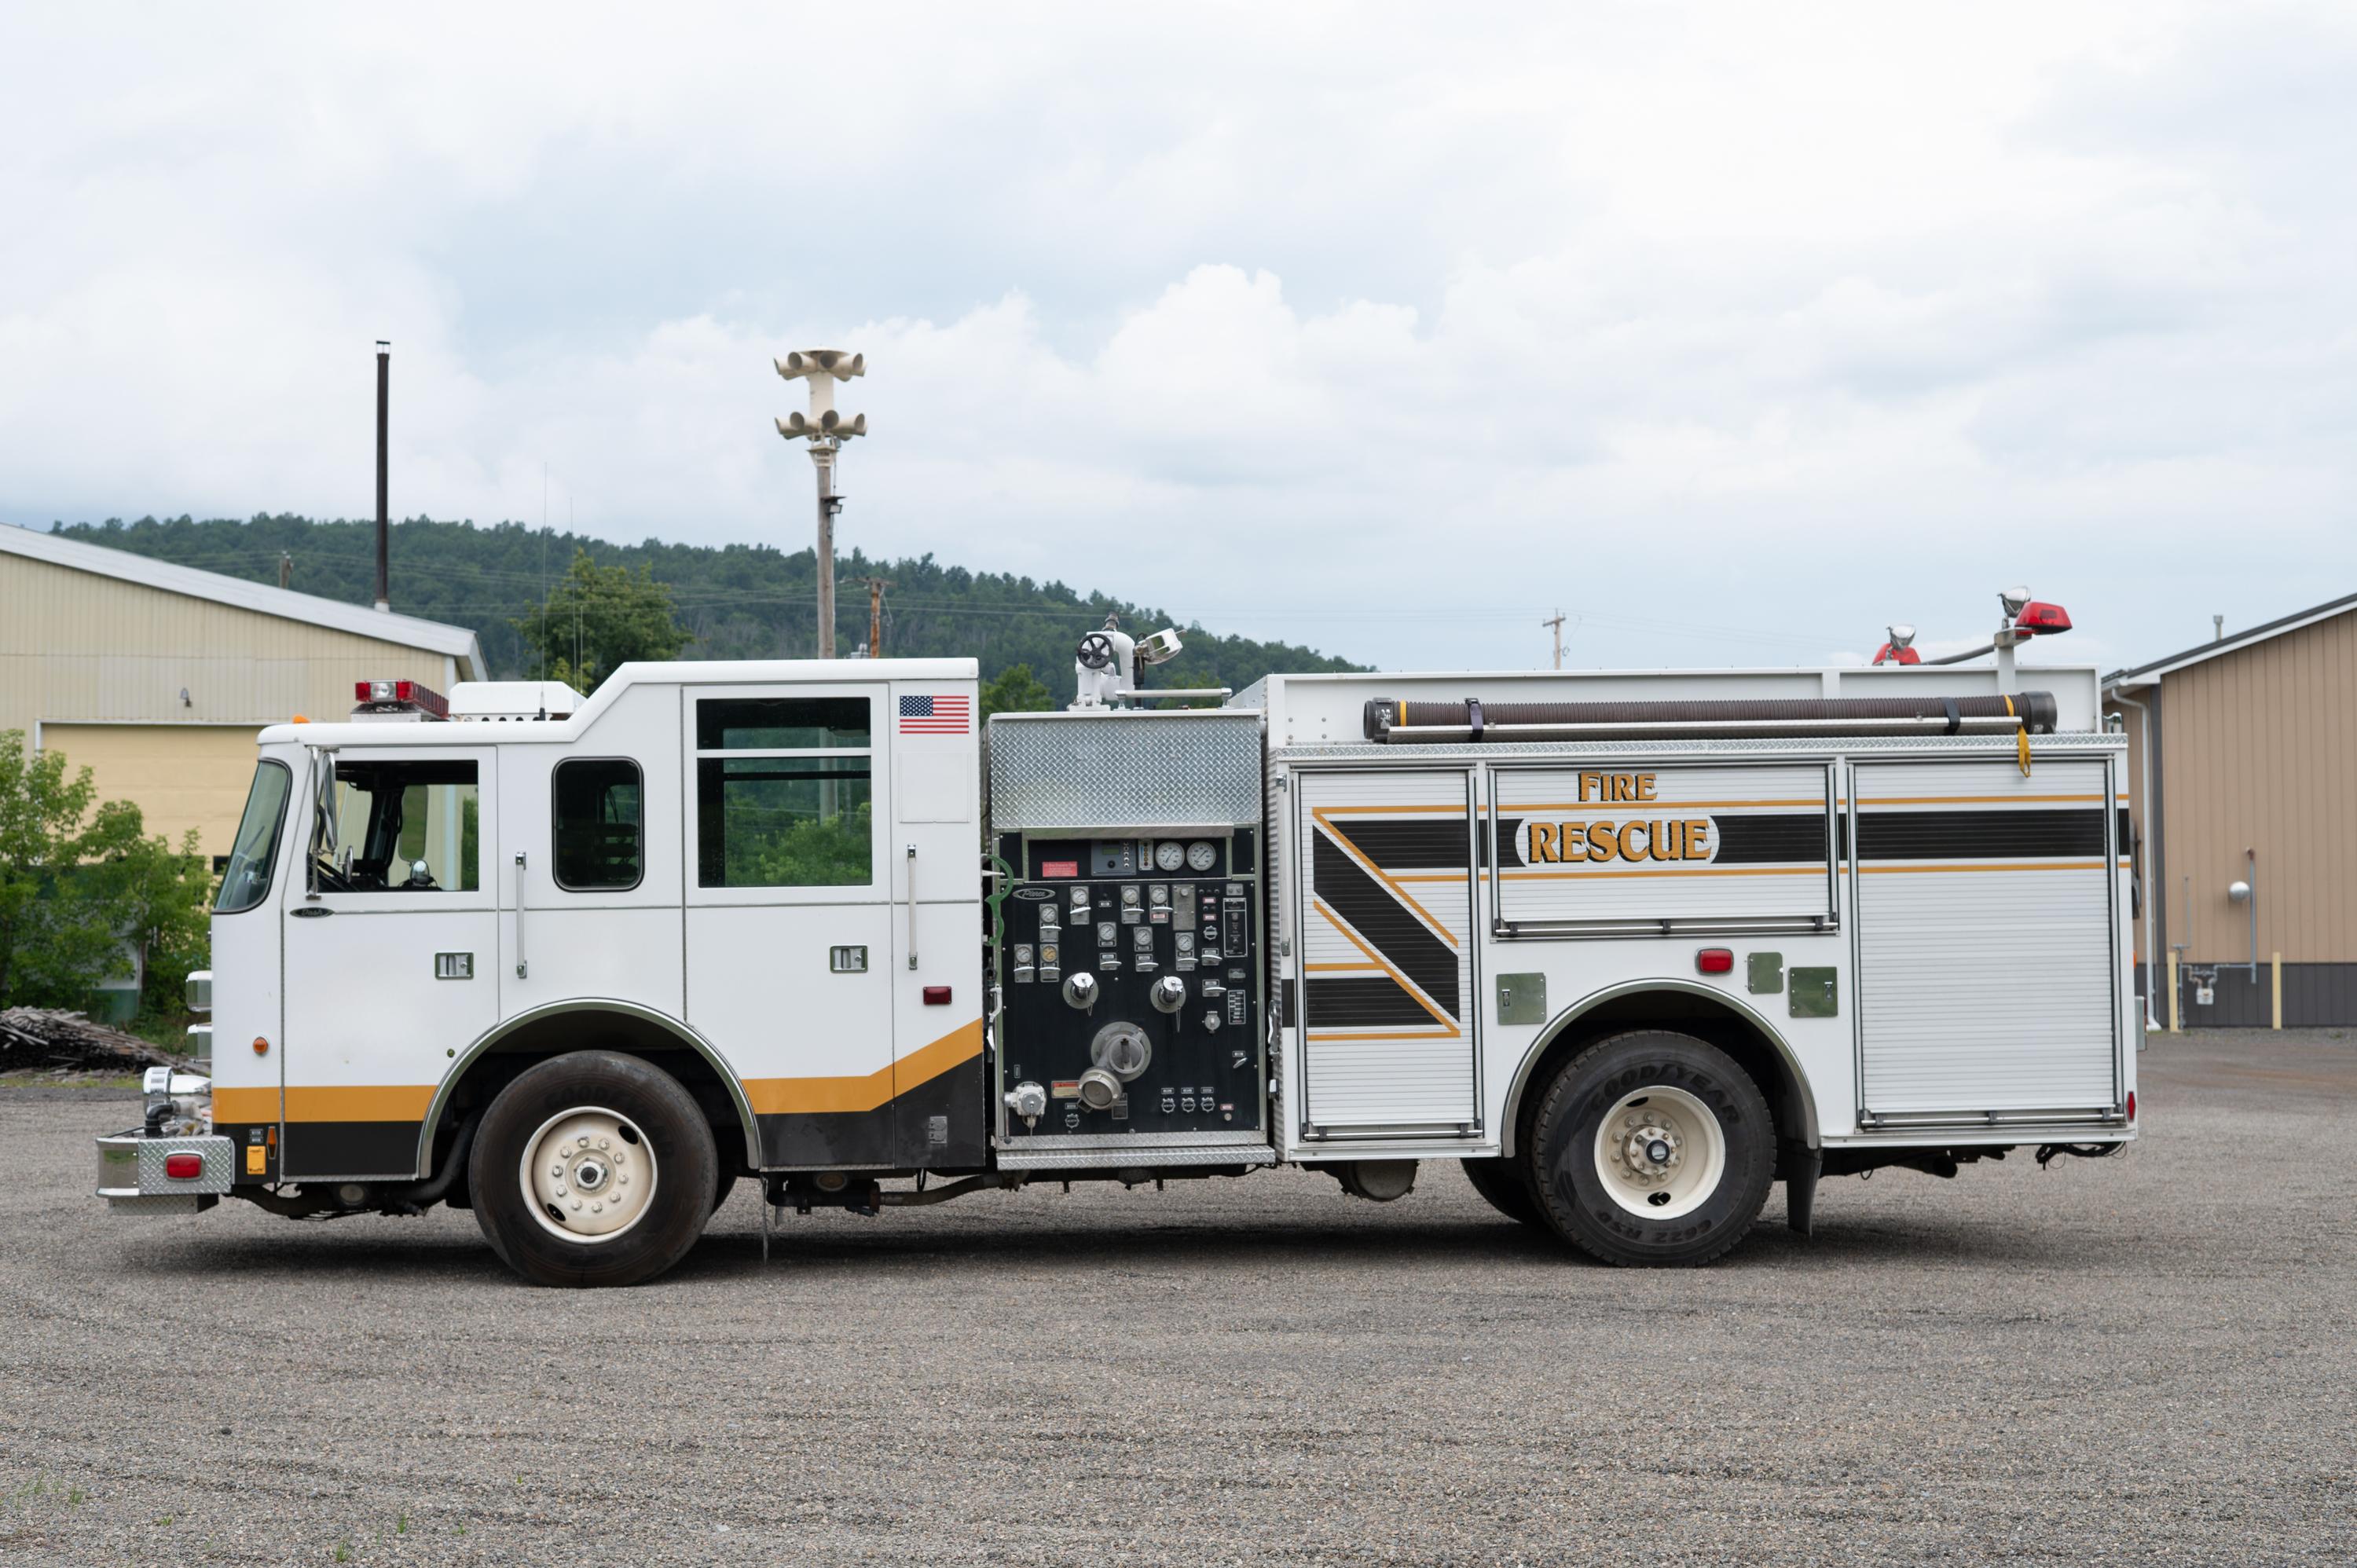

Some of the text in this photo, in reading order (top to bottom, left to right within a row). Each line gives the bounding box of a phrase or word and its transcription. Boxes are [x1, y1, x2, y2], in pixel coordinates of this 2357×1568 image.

[1578, 772, 1657, 801] FIRE
[1528, 819, 1711, 863] RESCUE
[1590, 1064, 1739, 1124] GOODYEAR
